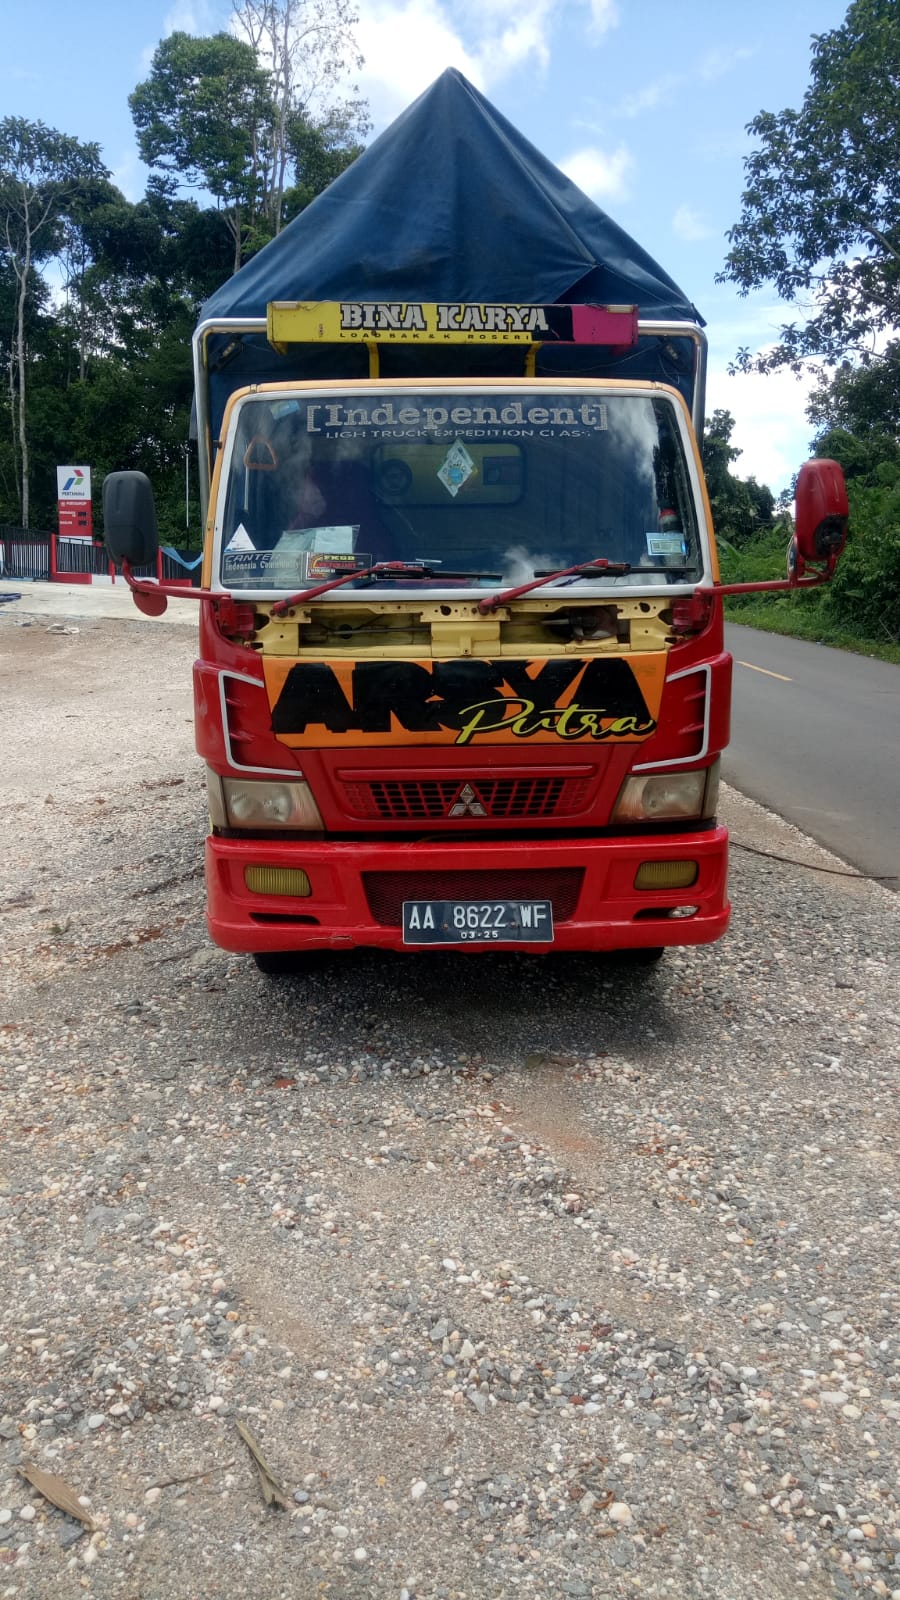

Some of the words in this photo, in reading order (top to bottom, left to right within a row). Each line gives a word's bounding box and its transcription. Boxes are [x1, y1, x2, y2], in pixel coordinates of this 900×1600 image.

[340, 304, 428, 331] BINA
[437, 305, 550, 332] KARYA
[371, 430, 428, 438] TRUCK
[434, 429, 535, 438] EXPEDITION
[454, 697, 656, 745] Putra
[408, 904, 435, 930] AA
[453, 904, 506, 929] 8622
[520, 904, 547, 928] WF
